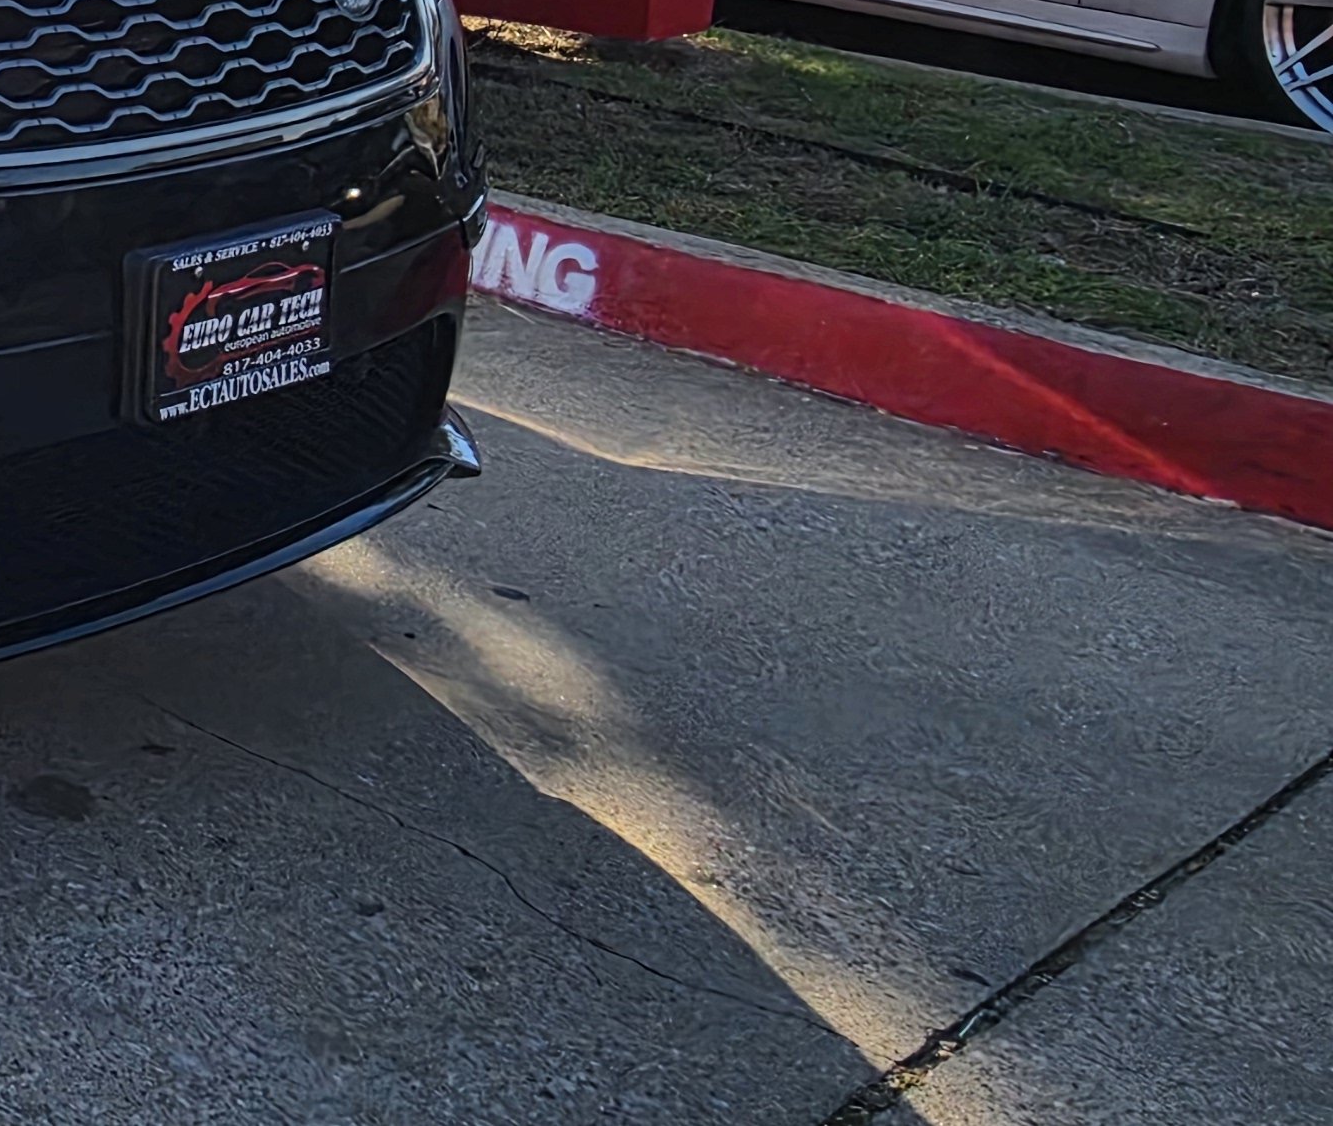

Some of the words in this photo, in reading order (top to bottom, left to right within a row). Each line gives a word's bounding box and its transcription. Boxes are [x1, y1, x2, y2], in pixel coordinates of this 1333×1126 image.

[172, 253, 203, 272] SALES
[204, 251, 214, 264] &
[214, 241, 259, 262] SERVICE
[179, 314, 232, 353] EURO
[236, 302, 275, 336] CAR
[278, 287, 323, 325] TECH
[224, 332, 269, 352] european
[270, 317, 322, 339] automotive
[222, 337, 321, 375] 817-404-4033
